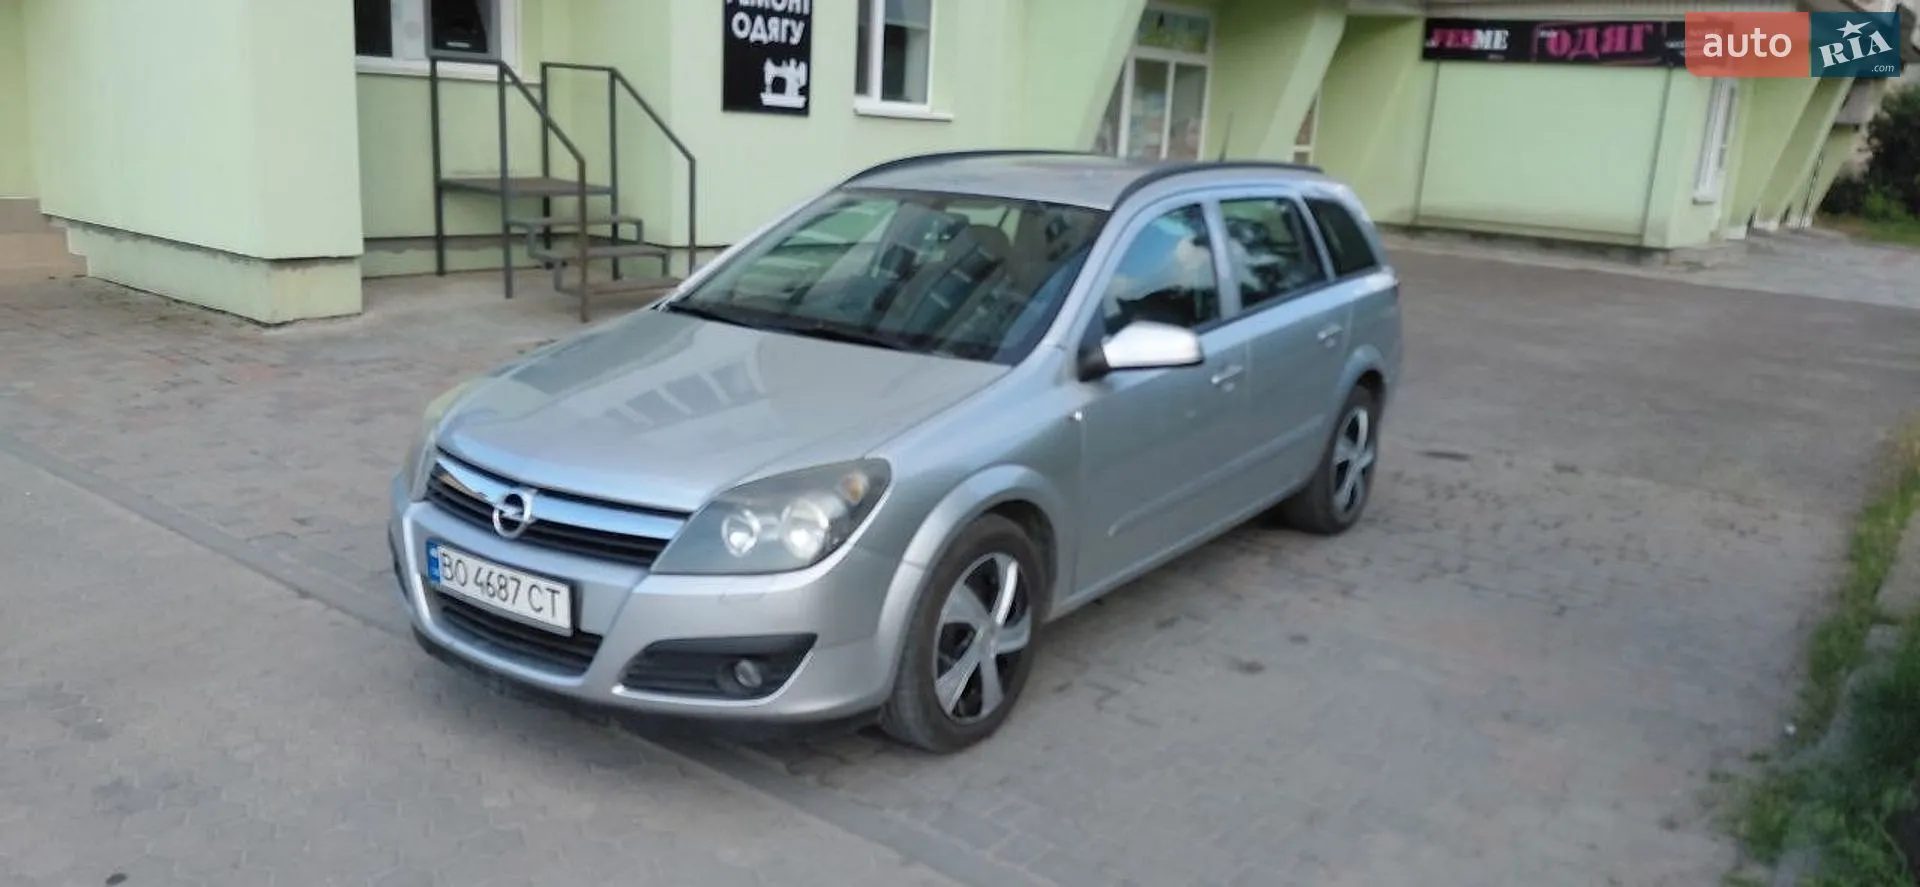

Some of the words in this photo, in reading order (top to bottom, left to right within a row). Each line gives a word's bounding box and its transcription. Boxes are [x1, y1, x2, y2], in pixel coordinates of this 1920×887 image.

[731, 11, 805, 45] ОДЯГУ
[474, 566, 521, 605] 4687
[527, 584, 561, 618] CT
